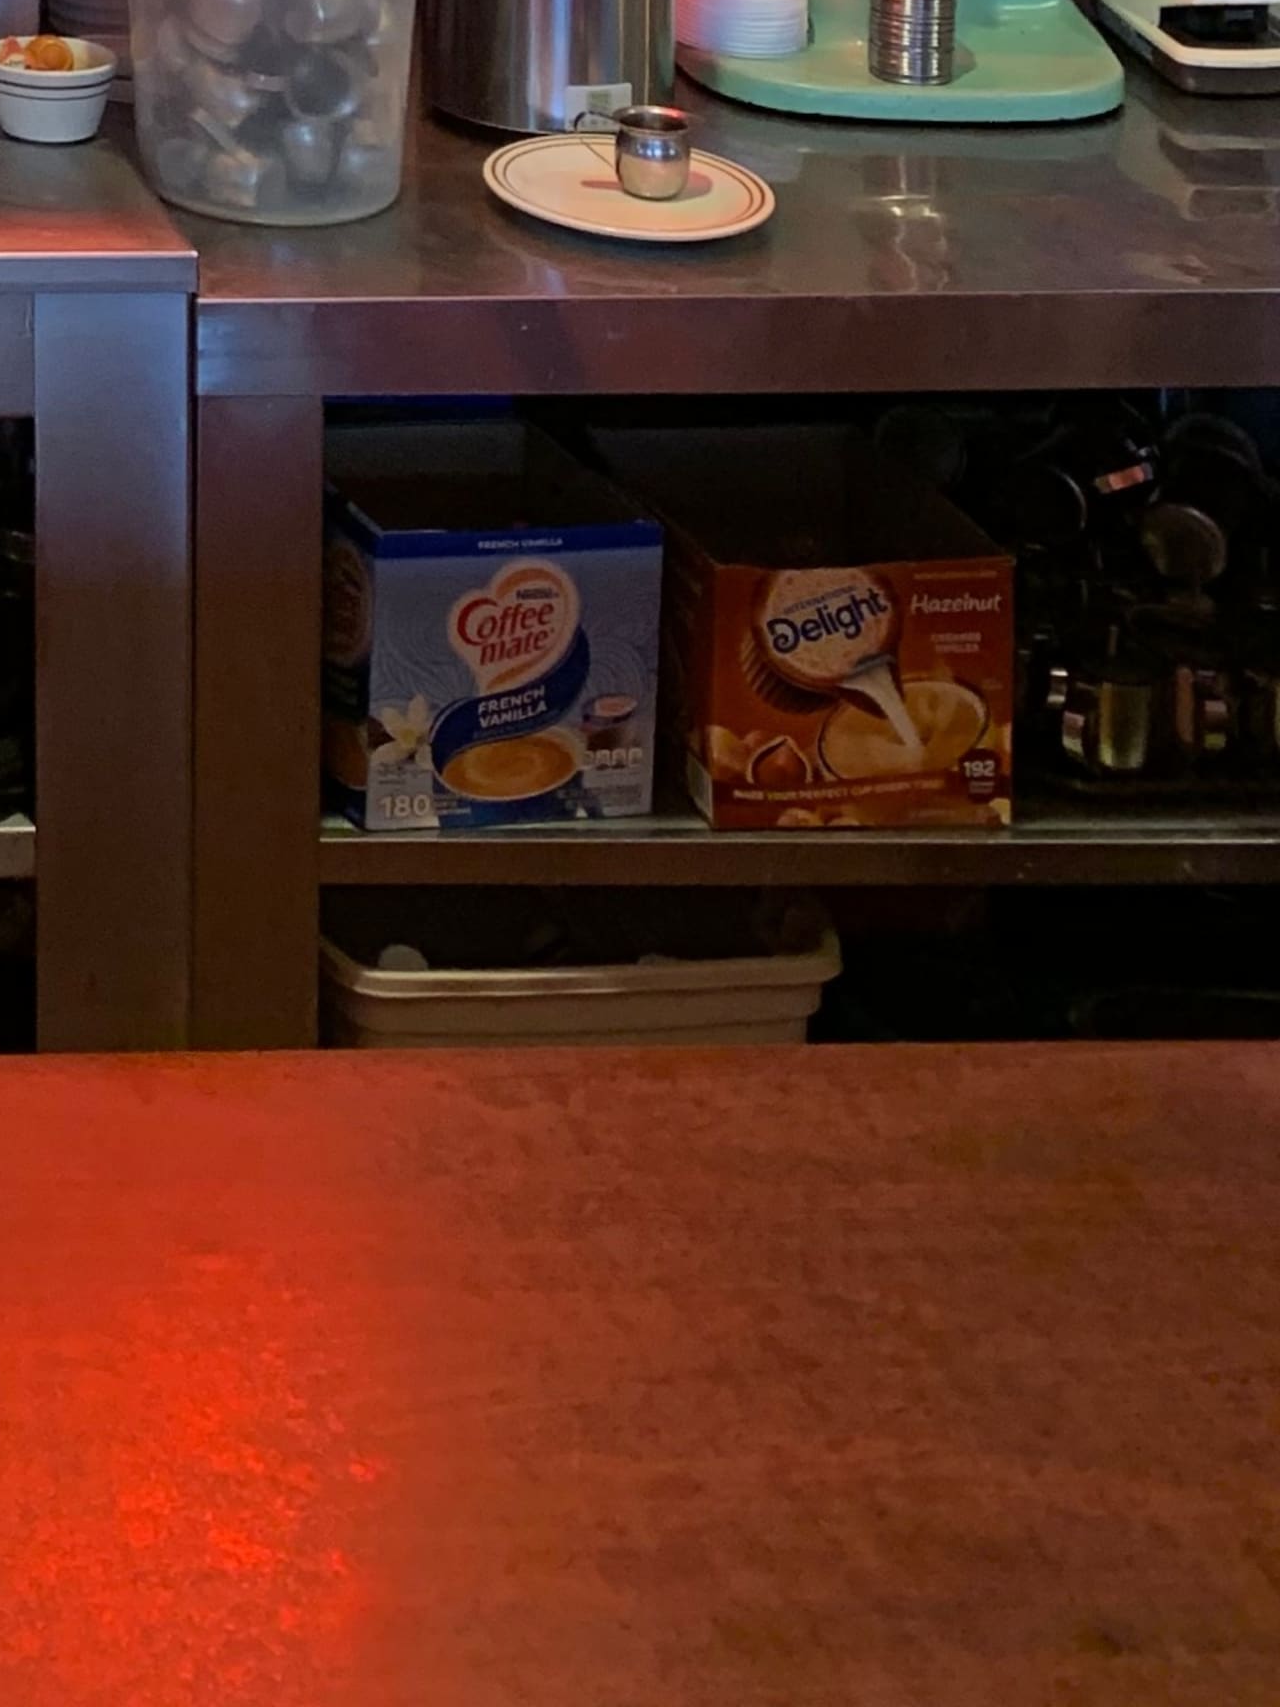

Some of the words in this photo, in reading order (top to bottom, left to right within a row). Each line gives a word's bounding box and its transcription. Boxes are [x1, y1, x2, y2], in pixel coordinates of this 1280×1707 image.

[477, 539, 519, 550] FRENCH
[910, 592, 1002, 615] Hazelnut
[457, 597, 555, 647] Coffee
[765, 587, 889, 655] Delight
[479, 627, 553, 667] mate
[477, 684, 546, 715] FRENCH
[479, 700, 548, 729] VANILLA
[963, 760, 996, 778] 192
[378, 794, 431, 818] 180
